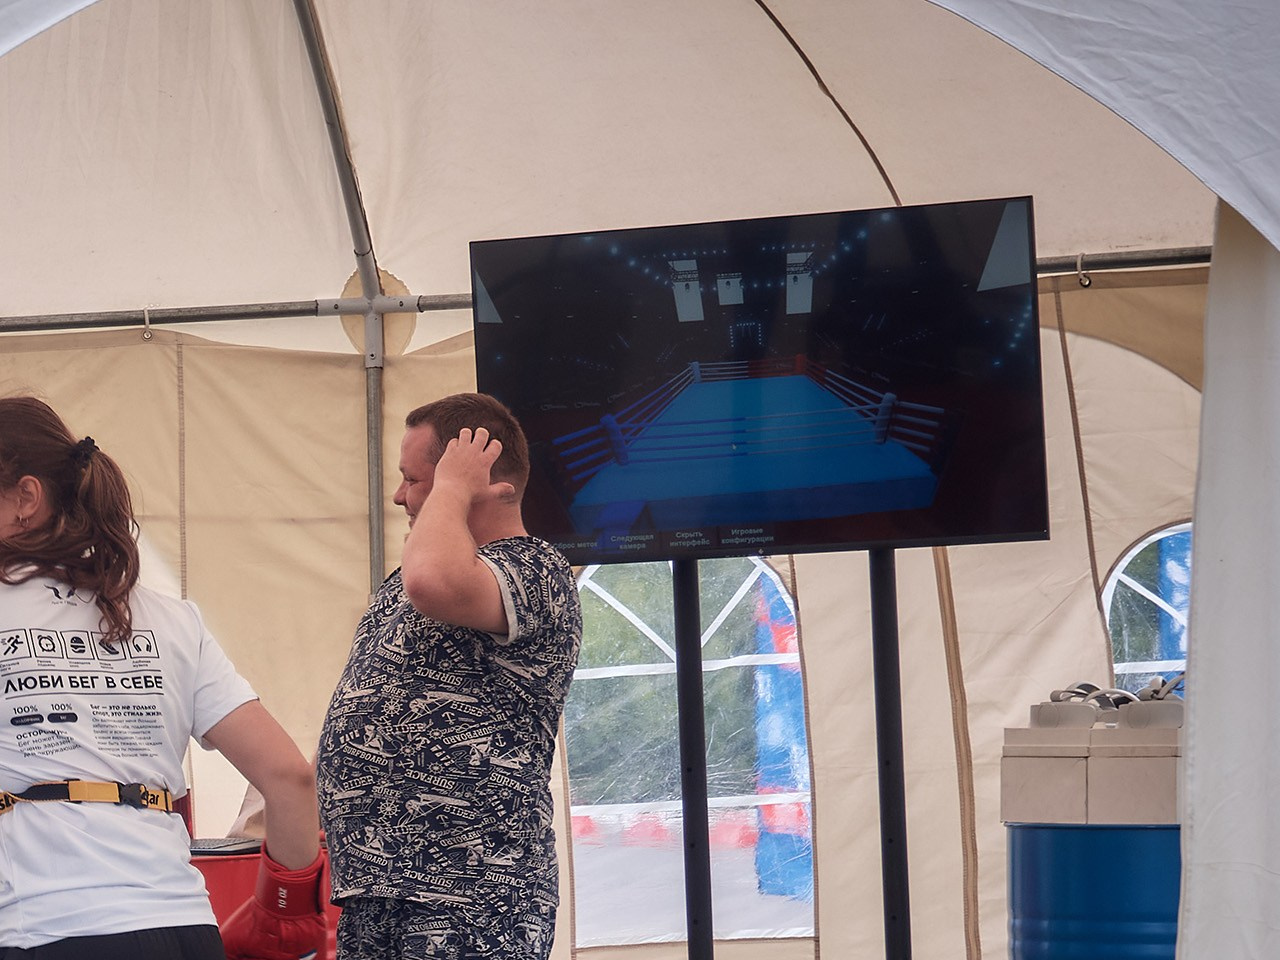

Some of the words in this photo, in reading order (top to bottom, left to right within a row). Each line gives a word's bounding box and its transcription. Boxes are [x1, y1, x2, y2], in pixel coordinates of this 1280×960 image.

[610, 534, 654, 543] Следующая
[675, 531, 704, 539] Скрыть
[731, 528, 764, 536] Игровые
[620, 543, 646, 551] камера
[670, 539, 710, 547] интерфейс
[721, 536, 774, 545] конфигурации
[4, 675, 64, 693] ЛЮБИ
[68, 676, 99, 689] БЕГ
[105, 676, 117, 689] В
[120, 675, 163, 689] СЕБЕ
[414, 666, 463, 686] SURFACE
[13, 705, 38, 715] 100%
[51, 703, 72, 711] 100%
[343, 745, 388, 766] SURFBOARD
[343, 775, 374, 791] RIDER
[404, 768, 455, 790] SURFACE
[489, 772, 532, 795] SURFACE
[440, 831, 482, 847] URFBOARD
[347, 846, 388, 866] SURFBOARD
[402, 869, 454, 888] SURFACE
[485, 872, 527, 888] SURFACE
[278, 899, 287, 908] 10
